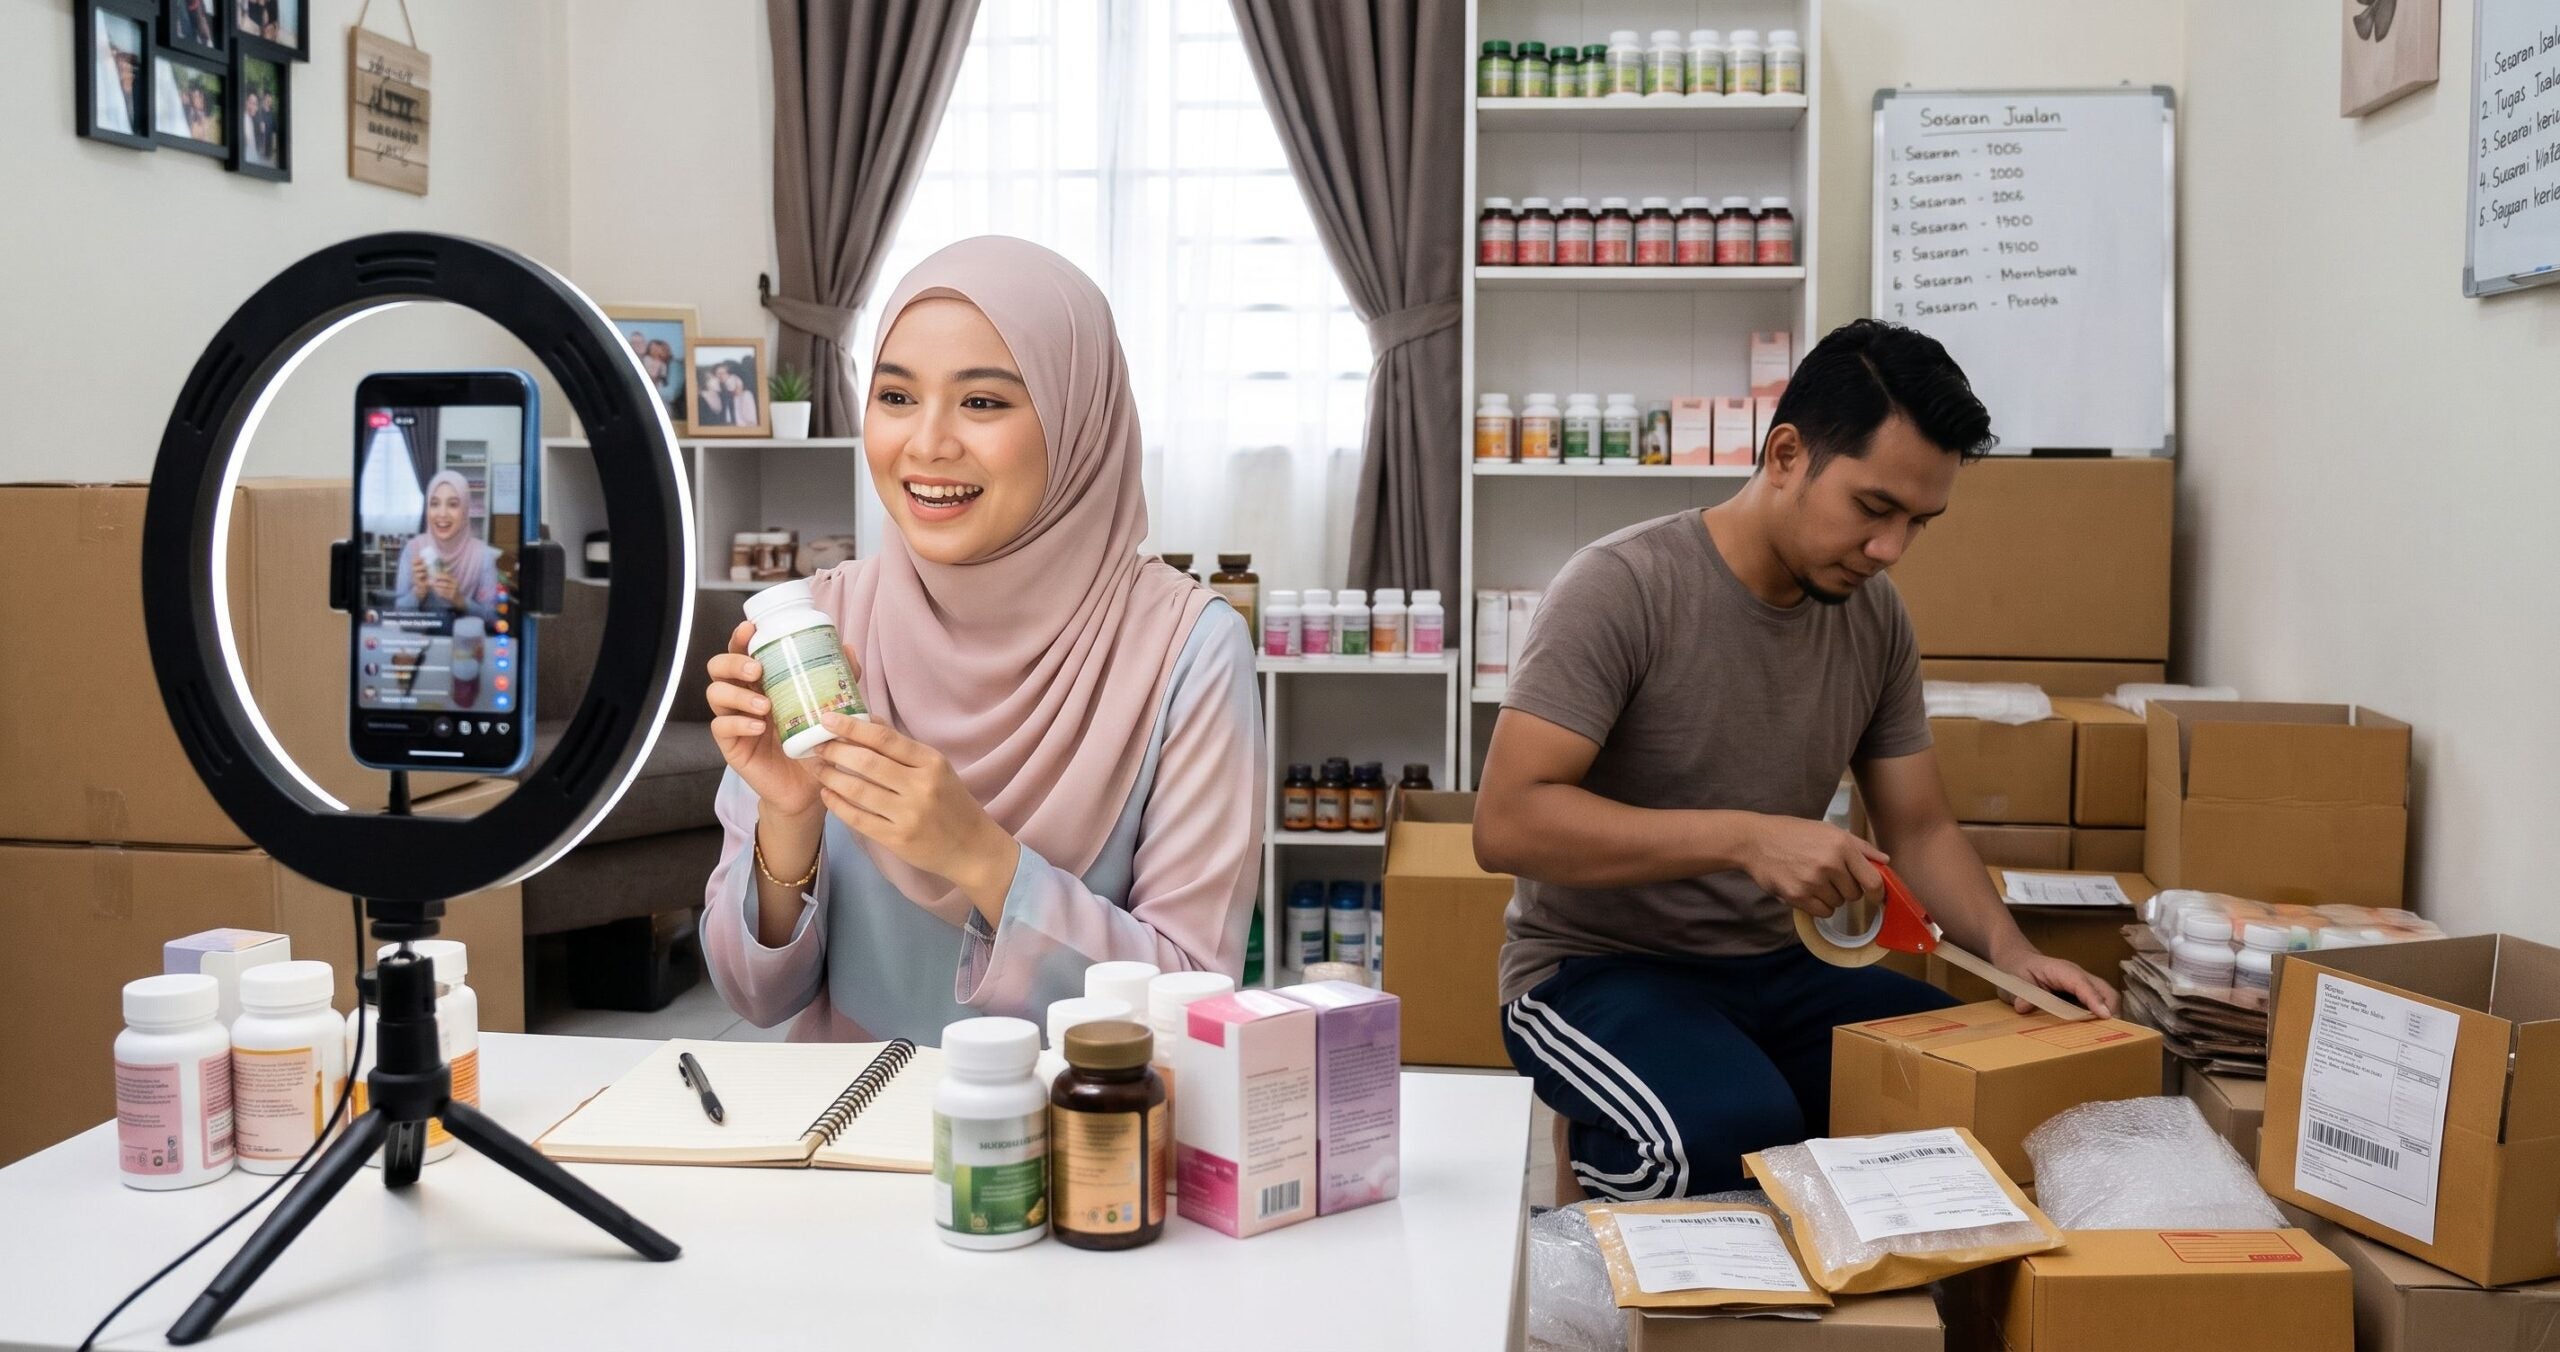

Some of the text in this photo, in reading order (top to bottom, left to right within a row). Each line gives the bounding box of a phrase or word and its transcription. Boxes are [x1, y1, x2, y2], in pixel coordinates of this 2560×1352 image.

[2483, 62, 2491, 82] 1.
[2481, 99, 2493, 120] 2.
[2494, 86, 2526, 119] Tugas
[2002, 105, 2062, 127] Jualan
[2480, 137, 2491, 158] 3.
[2479, 171, 2491, 194] 4.
